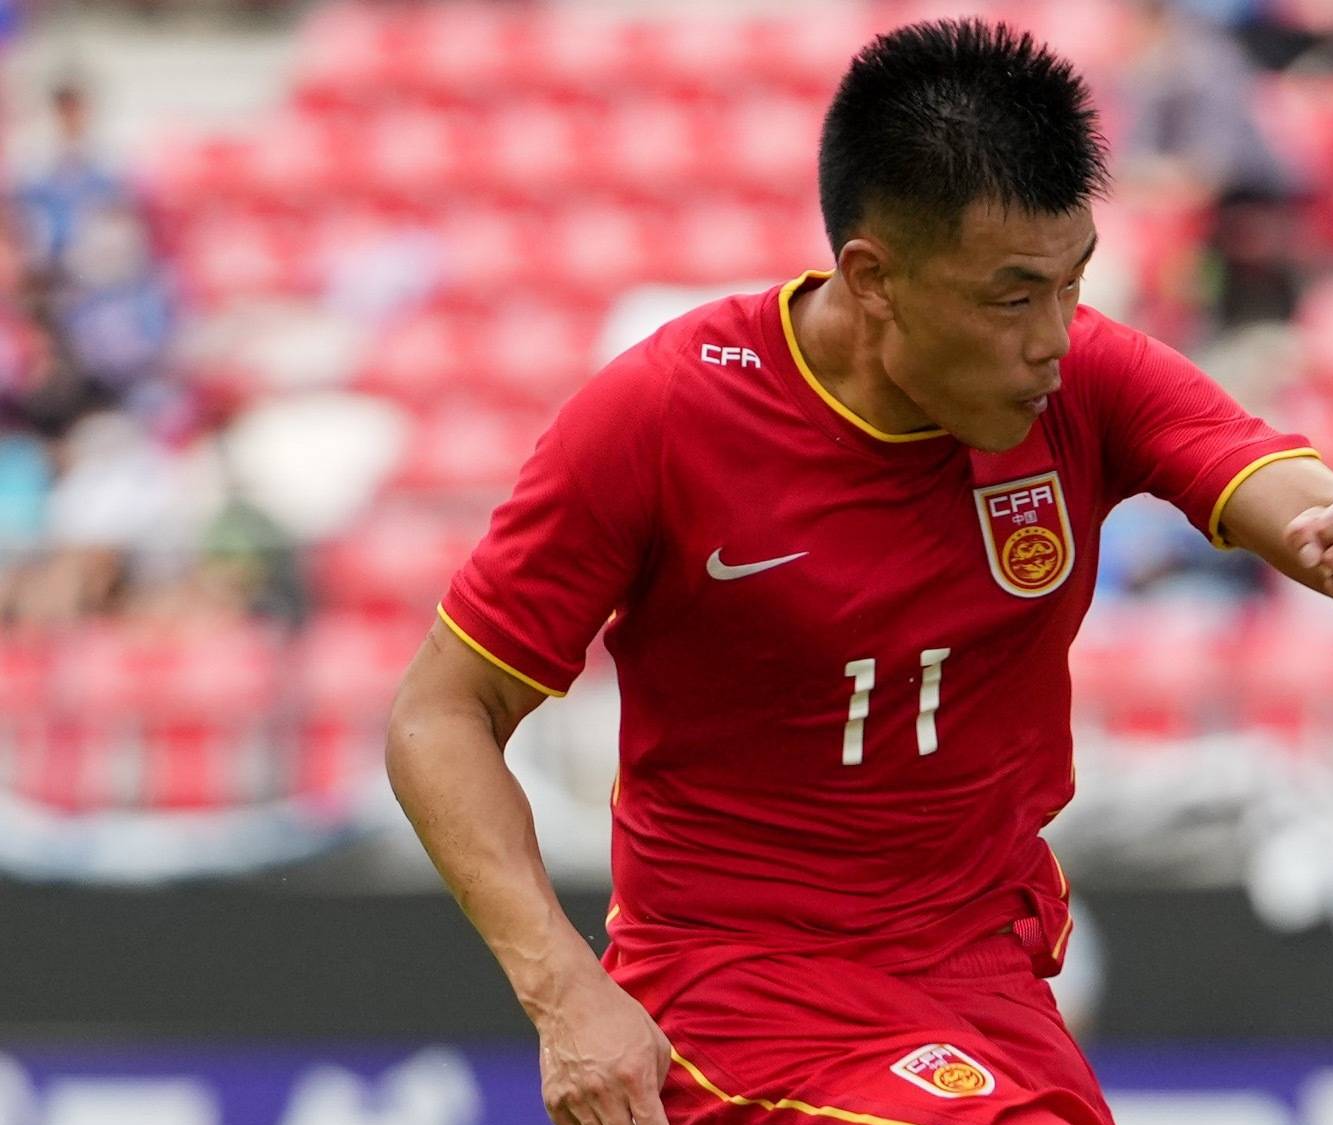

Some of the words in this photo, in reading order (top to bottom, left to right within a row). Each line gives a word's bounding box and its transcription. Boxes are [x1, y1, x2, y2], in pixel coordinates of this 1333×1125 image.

[701, 343, 761, 369] CFA
[989, 485, 1054, 518] CFA
[841, 647, 951, 766] 11
